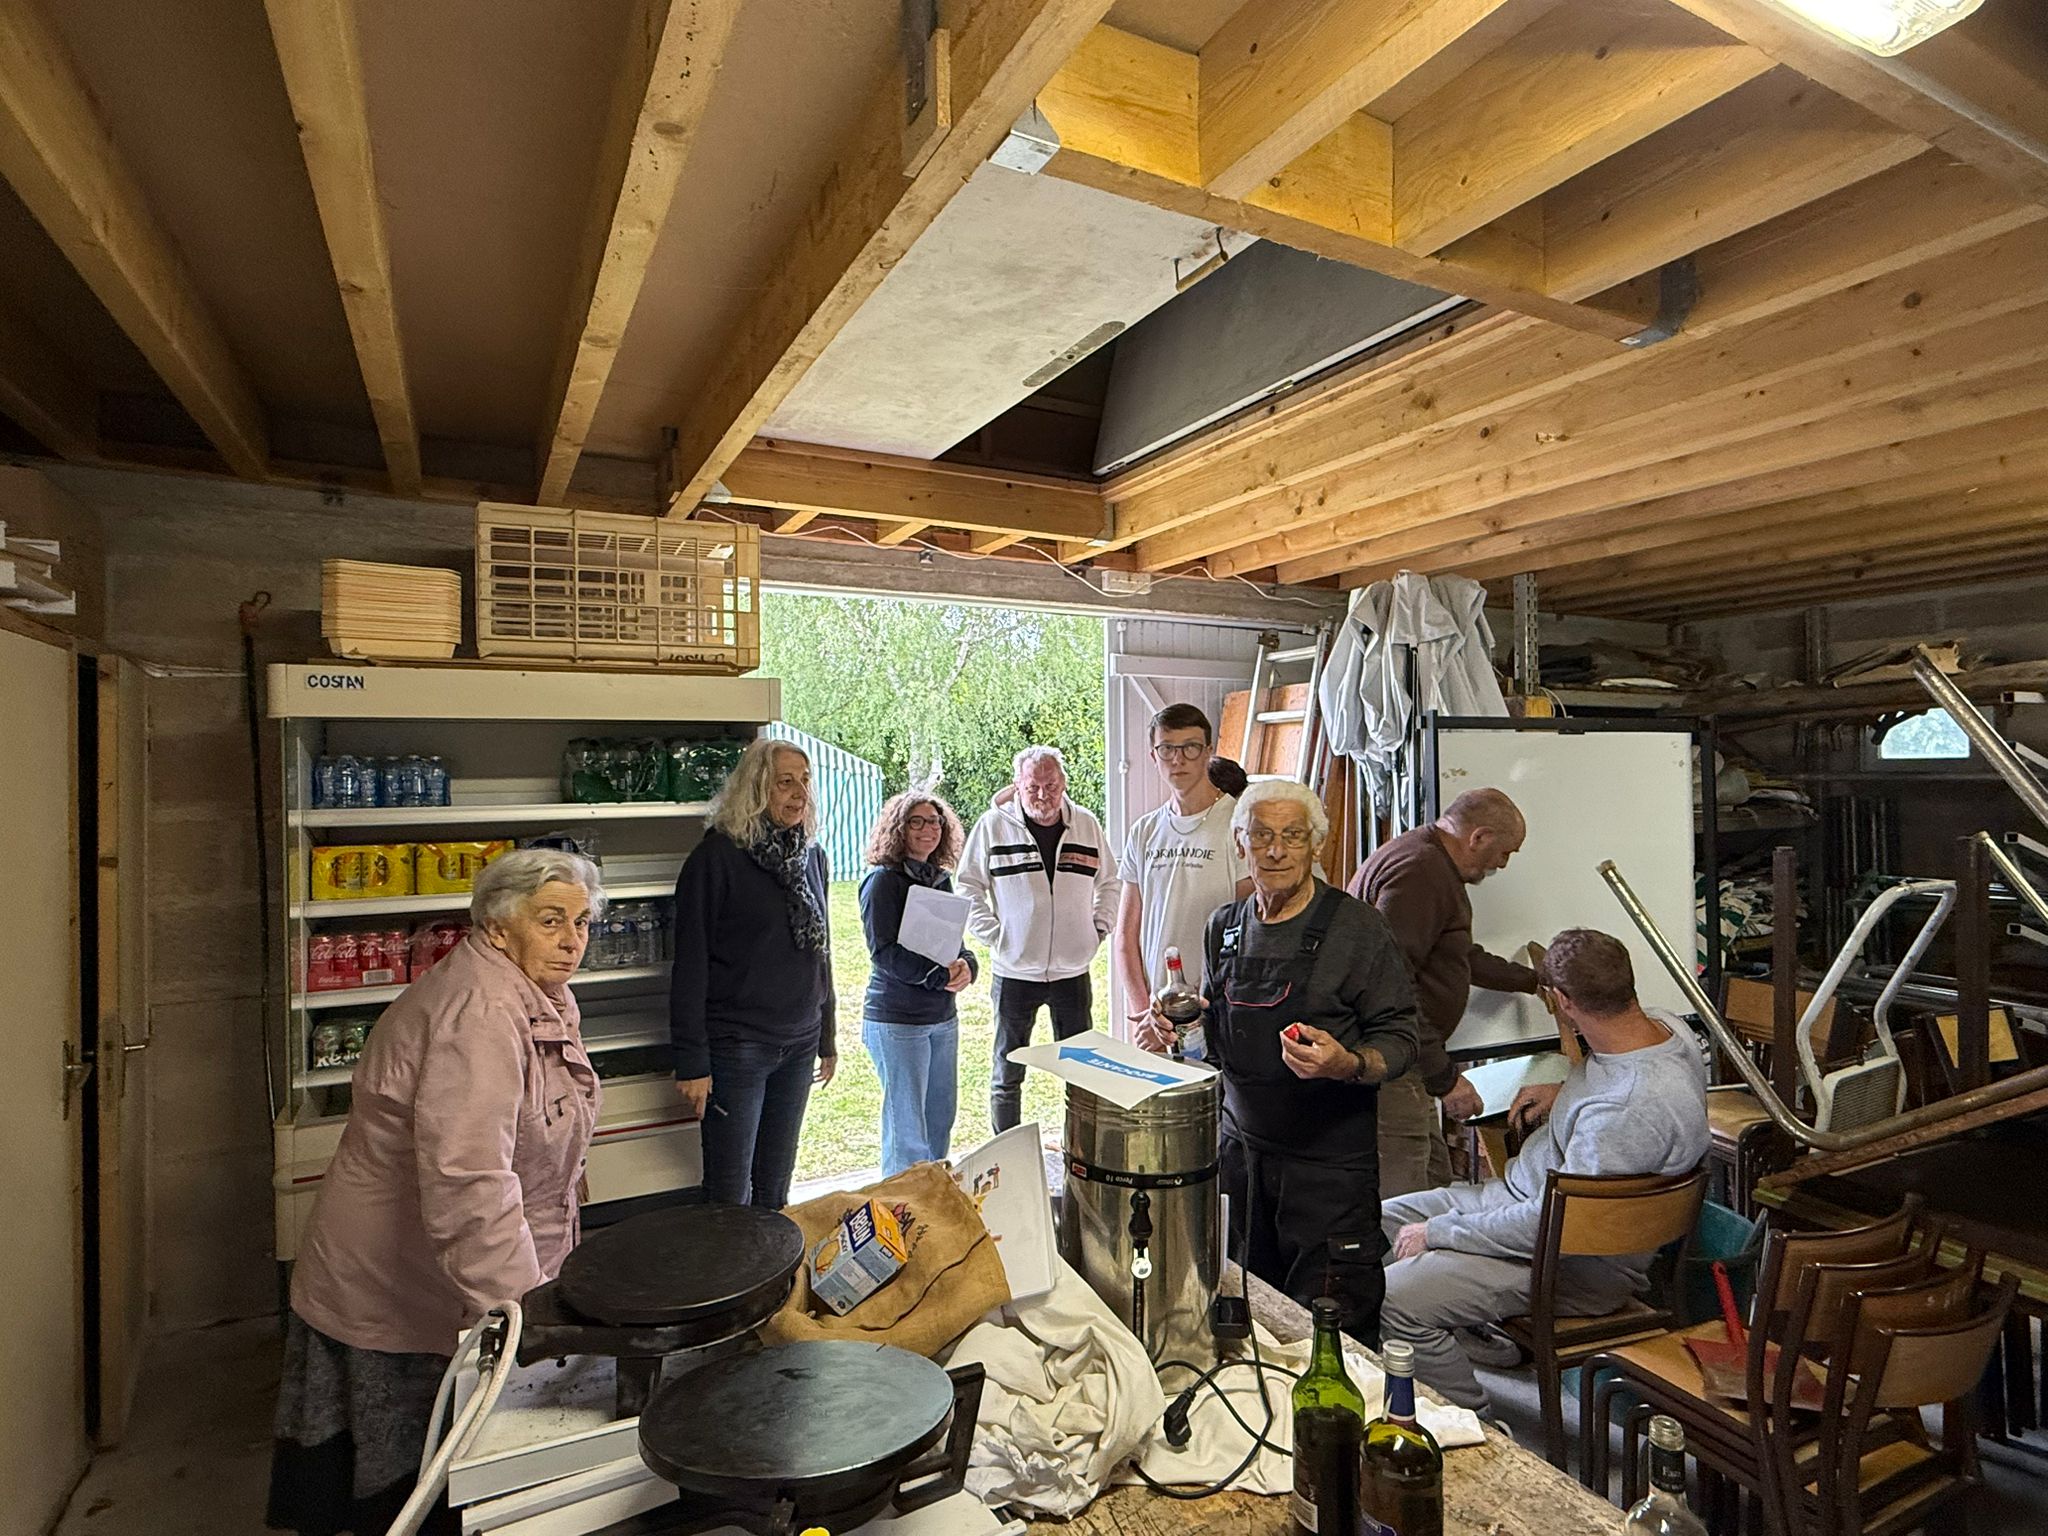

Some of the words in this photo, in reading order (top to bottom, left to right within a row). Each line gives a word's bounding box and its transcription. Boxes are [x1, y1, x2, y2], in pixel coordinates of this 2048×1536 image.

[307, 674, 364, 689] COSTAN
[1145, 847, 1216, 861] NORMANDIE
[1087, 1058, 1159, 1079] BROCANTE
